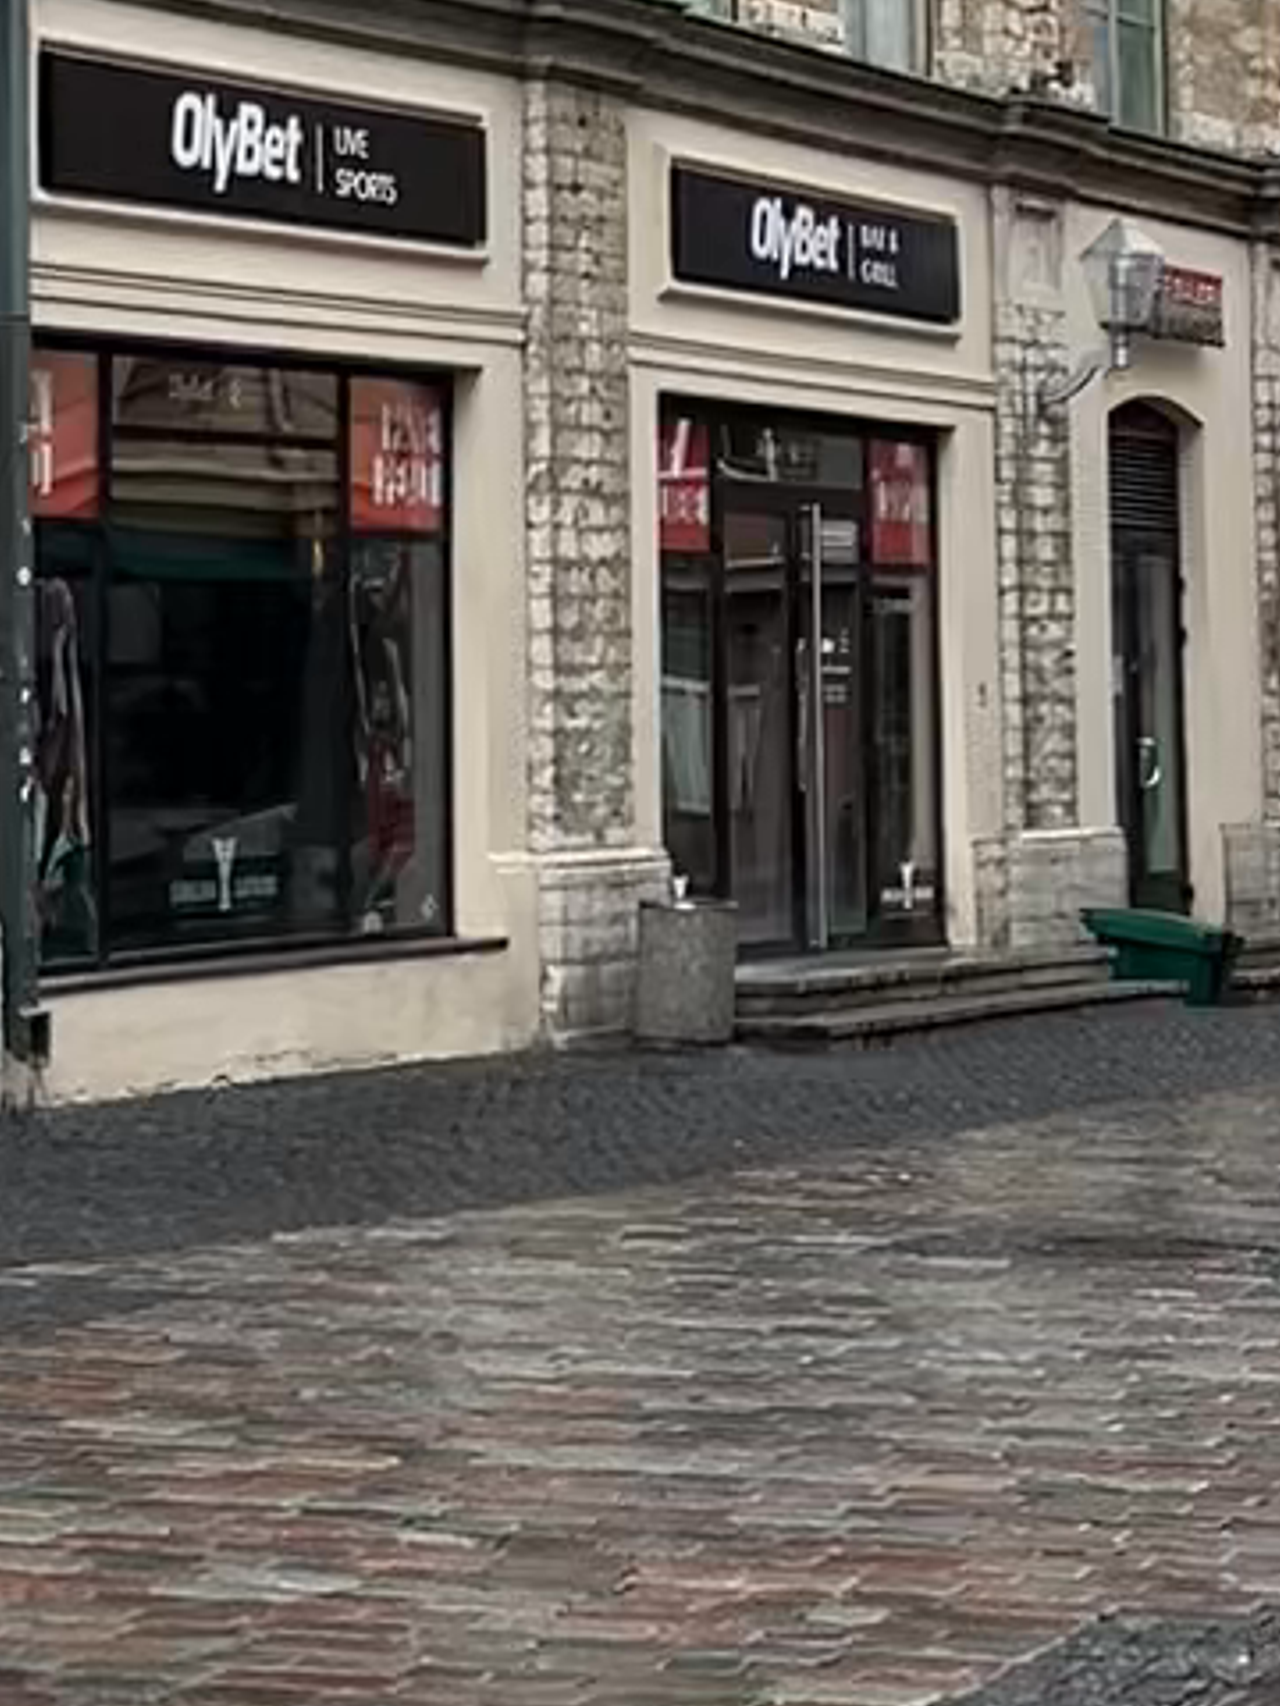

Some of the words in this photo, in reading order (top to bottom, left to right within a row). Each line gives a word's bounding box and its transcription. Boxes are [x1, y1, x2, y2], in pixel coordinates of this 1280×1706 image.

[173, 92, 303, 192] OlyBet
[336, 168, 398, 205] SPORTS
[752, 197, 840, 279] OlyBet
